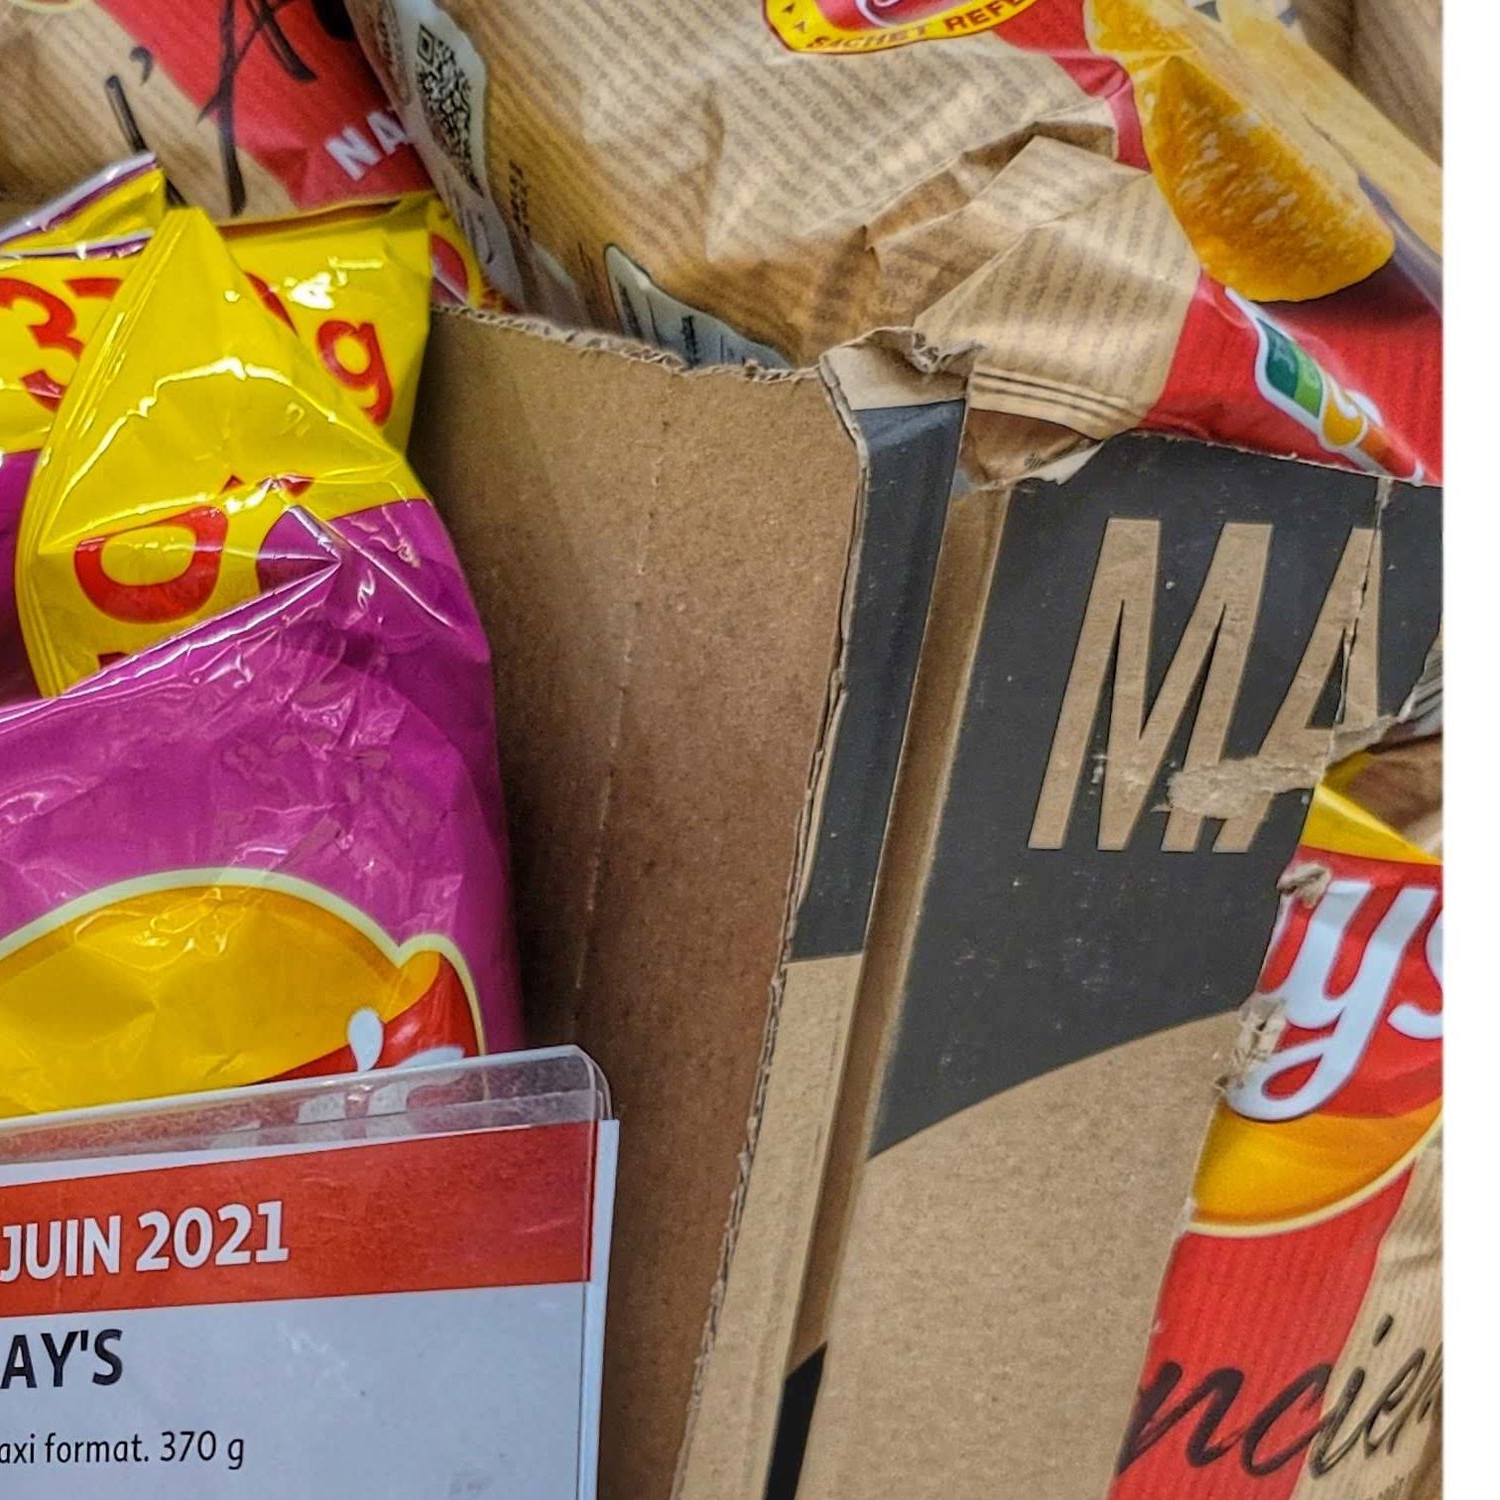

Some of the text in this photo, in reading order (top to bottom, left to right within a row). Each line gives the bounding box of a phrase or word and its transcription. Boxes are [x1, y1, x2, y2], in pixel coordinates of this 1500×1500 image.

[134, 1199, 291, 1273] 2021
[43, 1431, 151, 1465] format.
[159, 1428, 218, 1463] 370
[226, 1434, 246, 1471] g
